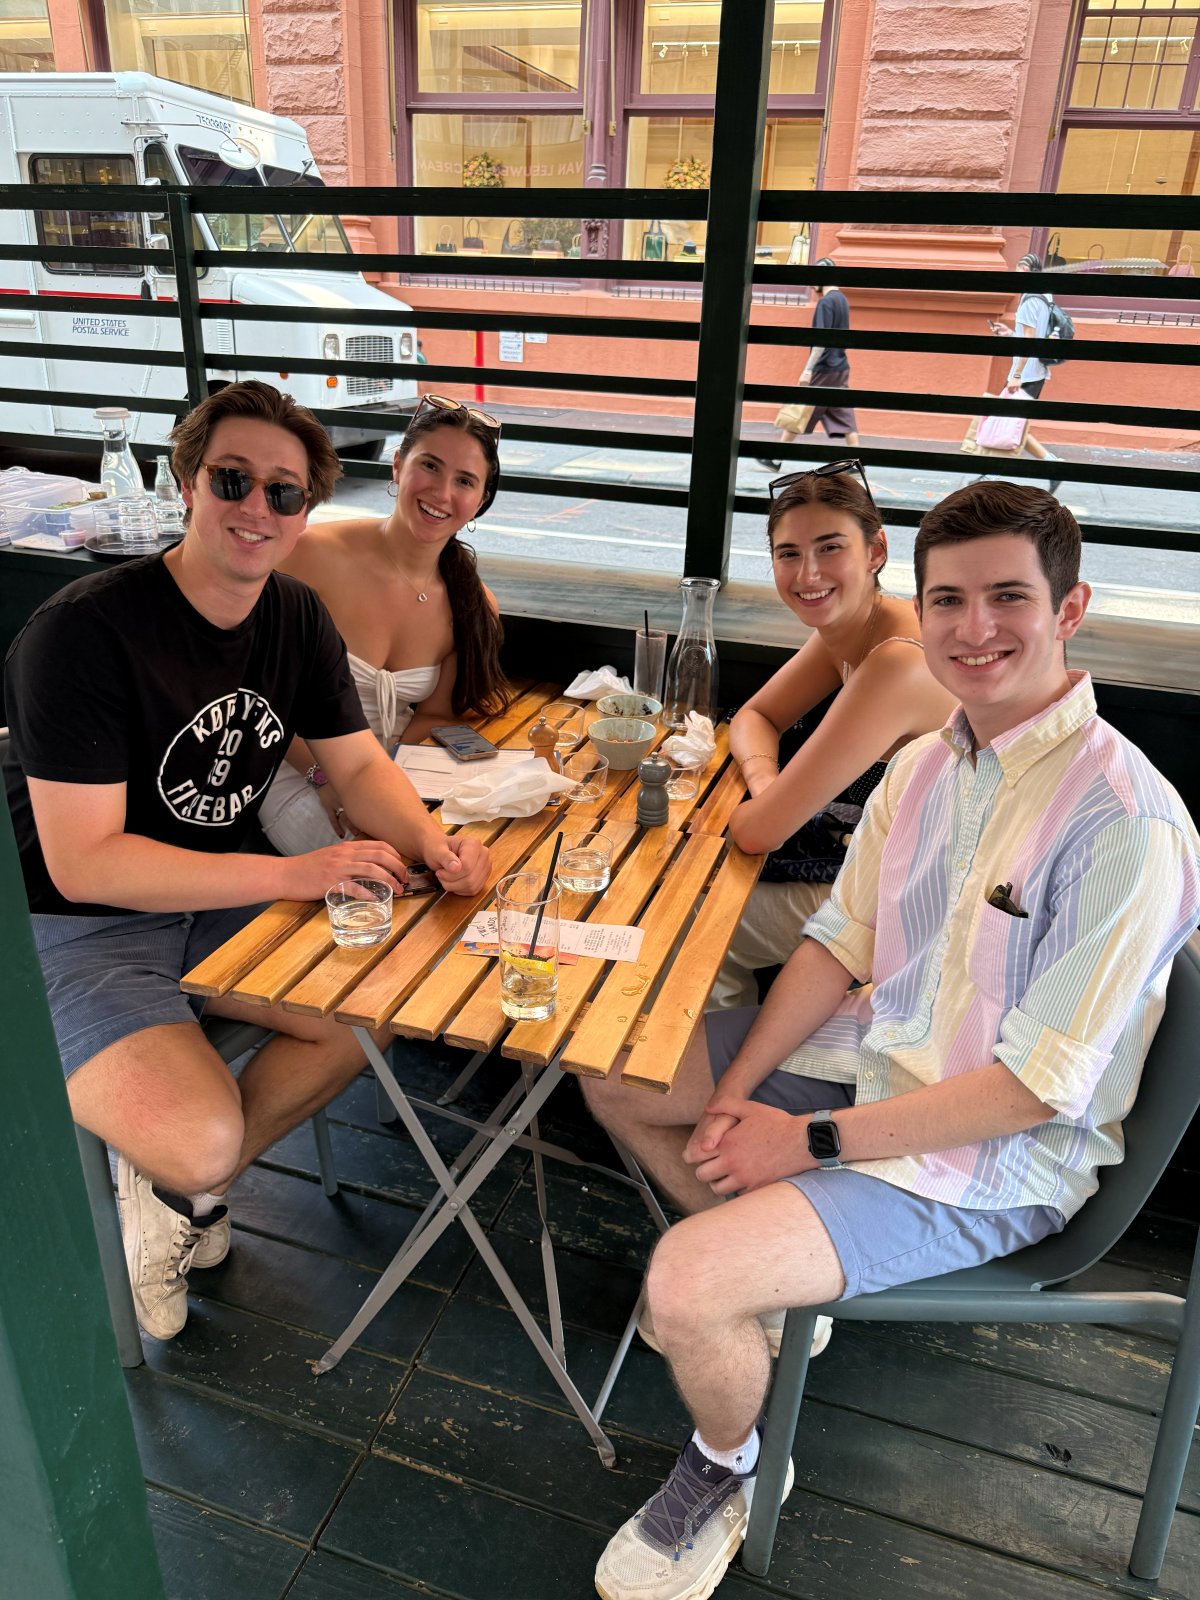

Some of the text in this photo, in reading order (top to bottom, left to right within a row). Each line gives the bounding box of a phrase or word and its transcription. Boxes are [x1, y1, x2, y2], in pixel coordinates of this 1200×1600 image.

[72, 317, 127, 328] UNITED STATES
[72, 326, 129, 337] POSTAL SERVICE
